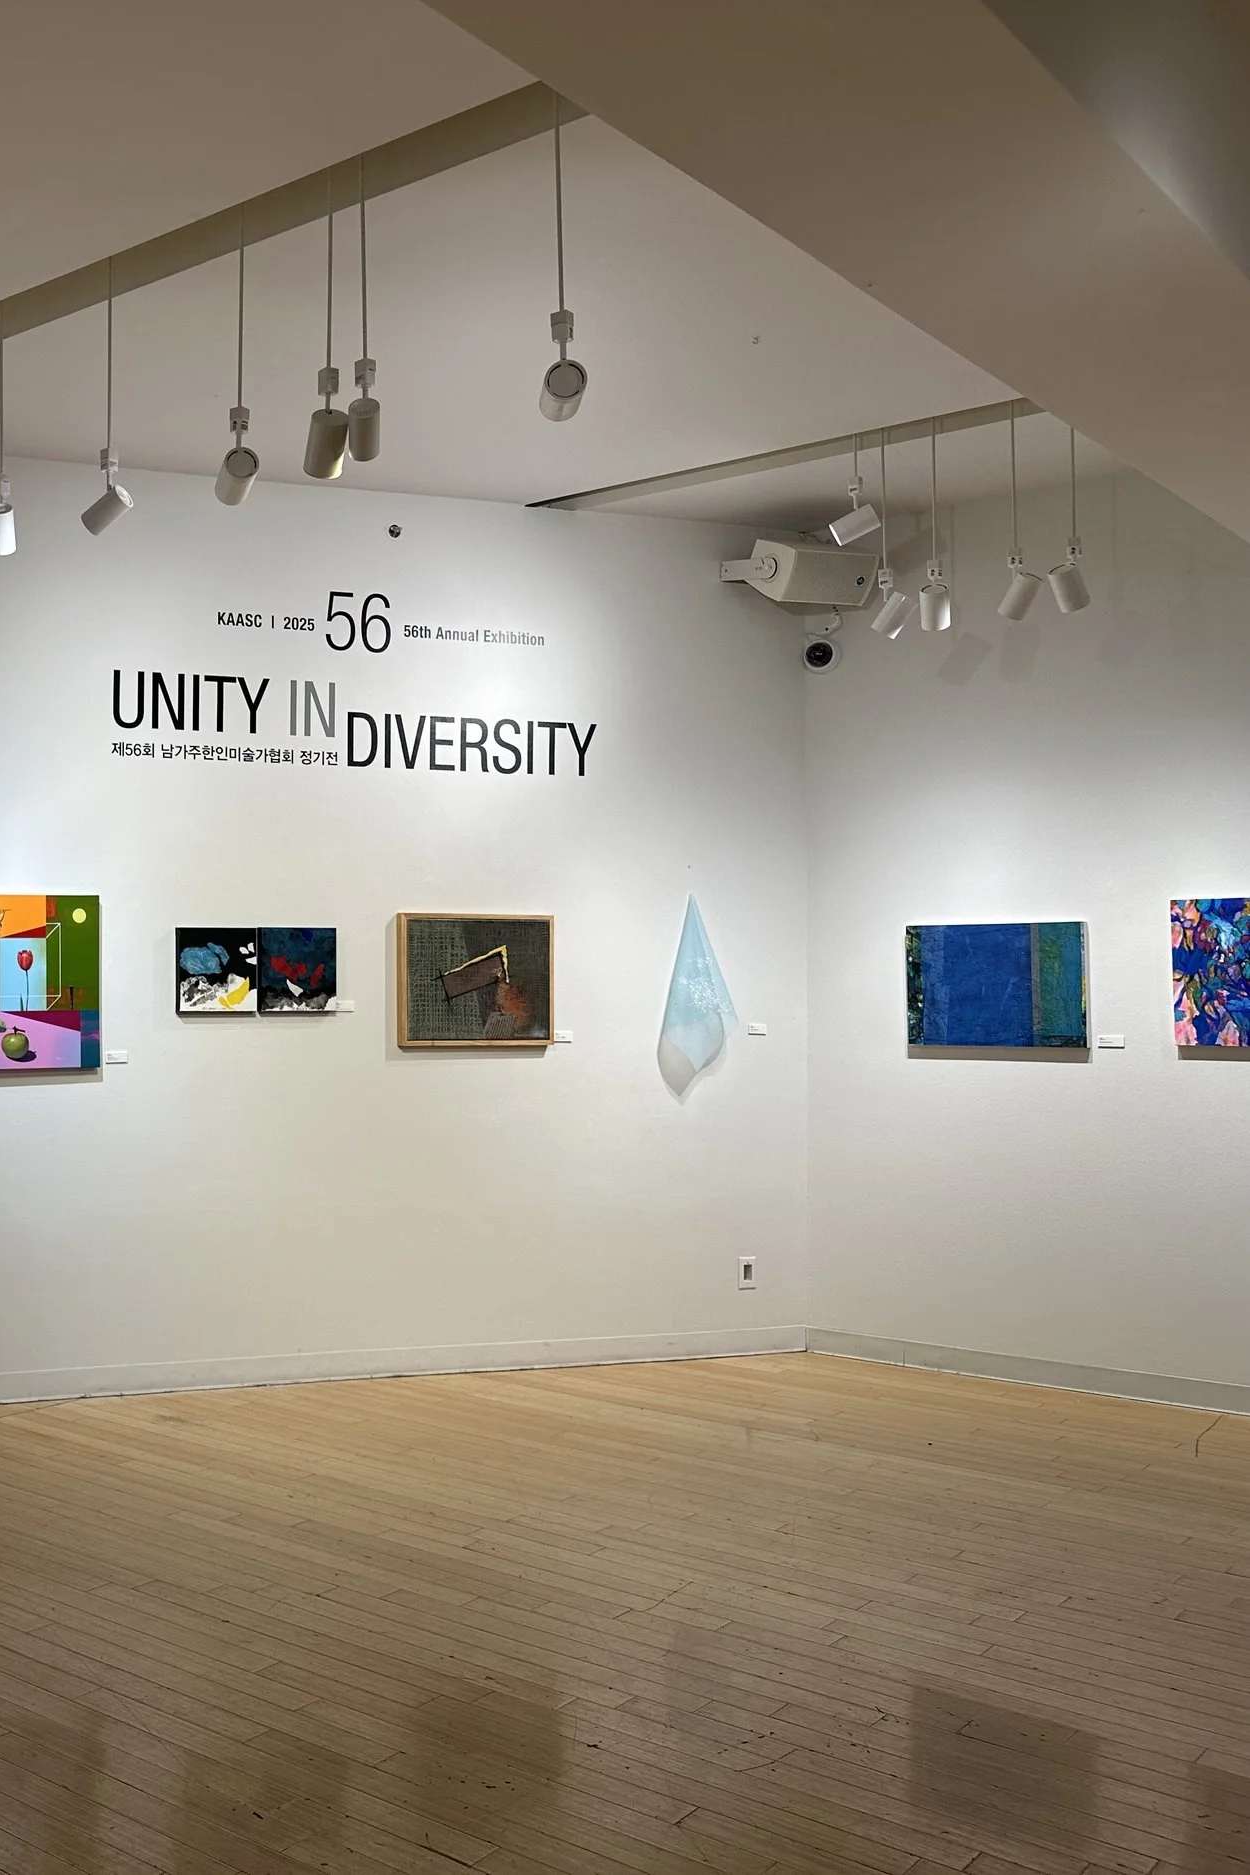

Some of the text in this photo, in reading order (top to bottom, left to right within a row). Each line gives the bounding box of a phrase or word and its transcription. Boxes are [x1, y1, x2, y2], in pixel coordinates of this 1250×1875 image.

[217, 611, 262, 628] KAASC
[283, 616, 315, 631] 2025
[325, 590, 391, 653] 56
[403, 624, 431, 639] 56th
[435, 626, 478, 642] Annual
[483, 629, 544, 646] Exhibition
[112, 668, 336, 738] UNITY IN
[110, 741, 339, 766] 제56회 남가주한인미술가협회 정기전
[346, 711, 597, 776] DIVERSITY
